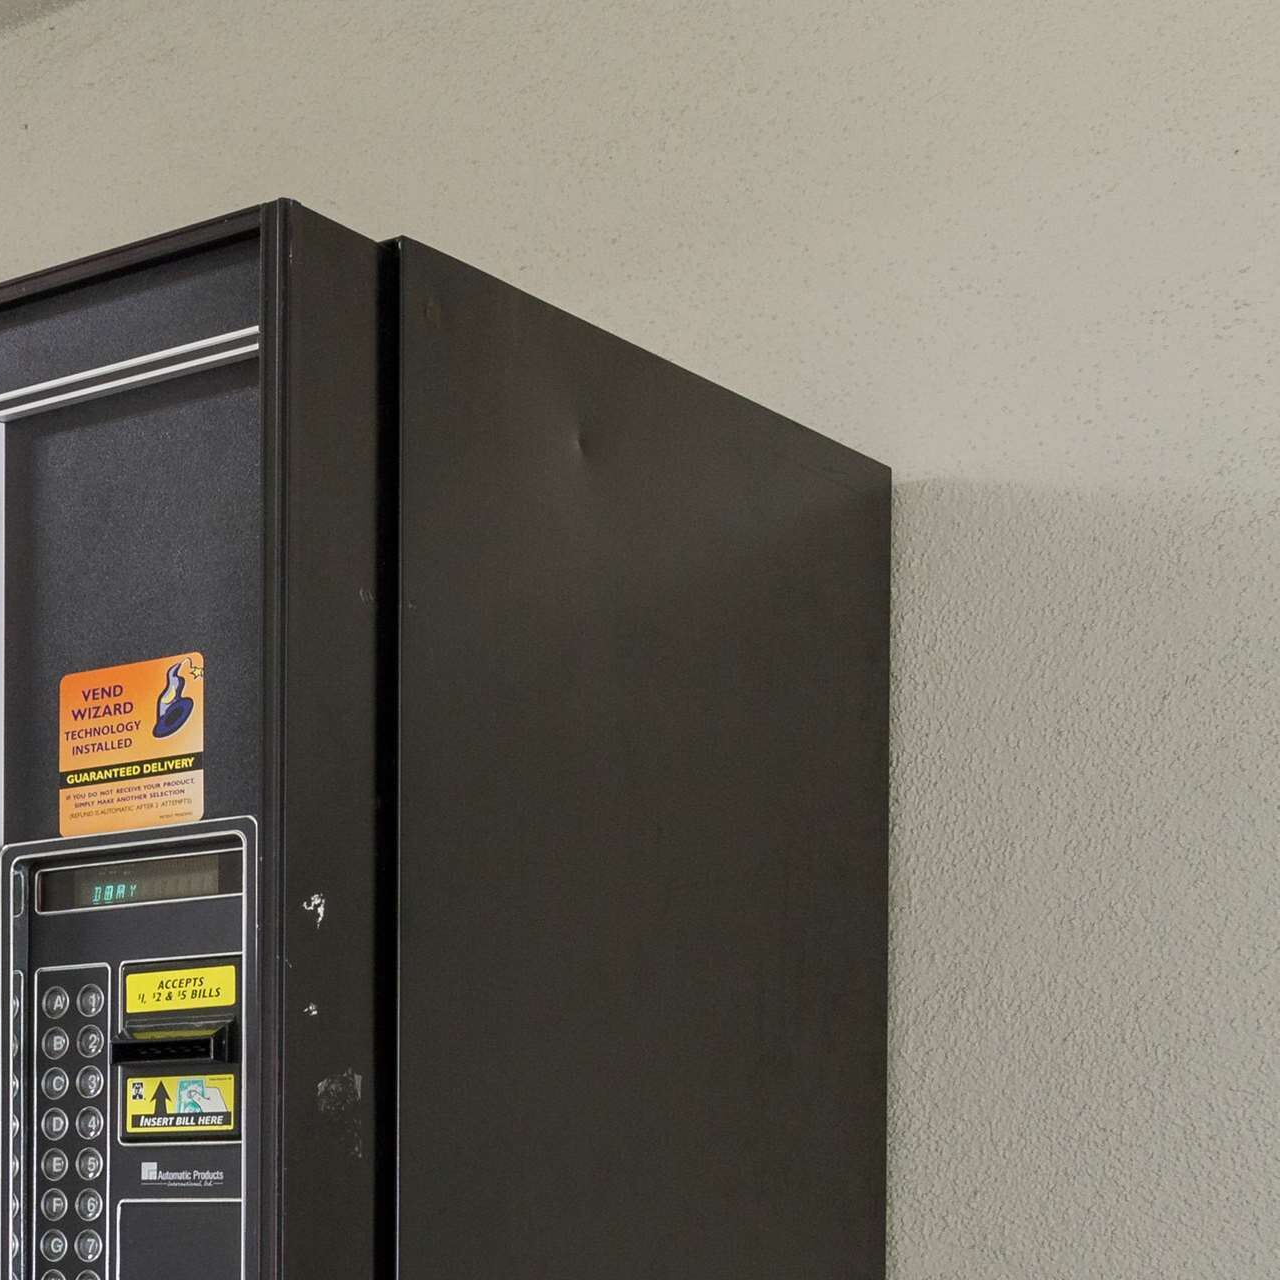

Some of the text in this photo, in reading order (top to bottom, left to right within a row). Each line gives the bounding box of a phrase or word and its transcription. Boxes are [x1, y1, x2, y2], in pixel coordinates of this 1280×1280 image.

[81, 684, 124, 701] VEND
[71, 702, 134, 721] WIZARD
[65, 720, 141, 742] TECHNOLOGY
[71, 737, 133, 756] INSTALLED
[66, 757, 194, 784] GUARANTEED DELIVERY
[73, 793, 86, 801] YOU
[116, 786, 141, 794] RECEIVE
[143, 783, 161, 791] YOUR
[116, 794, 147, 803] ANOTHER
[149, 789, 186, 799] SELECTION
[158, 976, 204, 990] ACCEPTS
[88, 993, 97, 1008] 1
[152, 990, 162, 1002] $2
[165, 990, 173, 1001] &
[178, 989, 187, 1001] $5
[190, 987, 221, 1000] BILLS
[53, 995, 64, 1011] A
[53, 1035, 64, 1051] B
[88, 1034, 97, 1049] 2
[52, 1075, 65, 1091] C
[88, 1074, 97, 1089] 3
[52, 1116, 64, 1132] D
[87, 1116, 97, 1132] 4
[139, 1115, 224, 1127] INSERT BILL HERE
[52, 1157, 63, 1172] E
[87, 1157, 97, 1172] 5
[158, 1169, 224, 1181] Automatic Products
[52, 1197, 63, 1213] F
[87, 1197, 97, 1212] 6
[51, 1237, 64, 1253] G
[86, 1238, 96, 1253] 7
